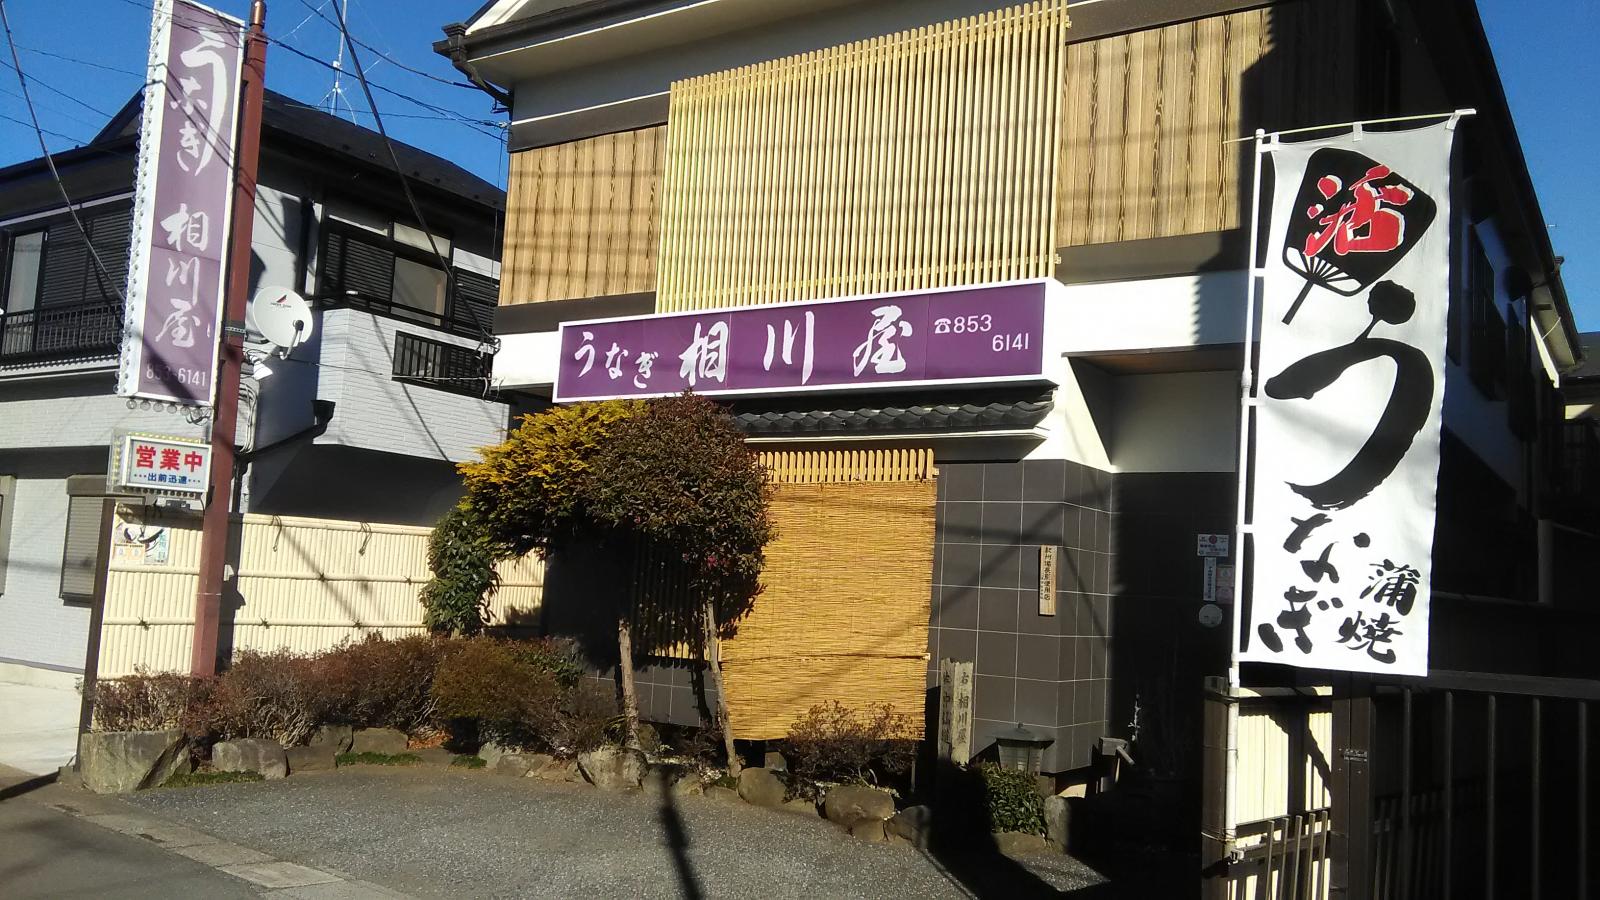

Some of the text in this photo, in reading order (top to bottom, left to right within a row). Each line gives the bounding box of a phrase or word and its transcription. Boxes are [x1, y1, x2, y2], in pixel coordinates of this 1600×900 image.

[155, 28, 227, 348] うなぎ 相川屋
[1303, 164, 1414, 257] 活
[574, 305, 913, 389] うなぎ 相川屋
[953, 313, 993, 334] 853
[992, 332, 1030, 352] 6141
[136, 445, 203, 472] 営業中
[147, 472, 188, 485] 出前迅速
[1258, 279, 1435, 655] うなぎ
[1334, 559, 1421, 664] 蒲焼
